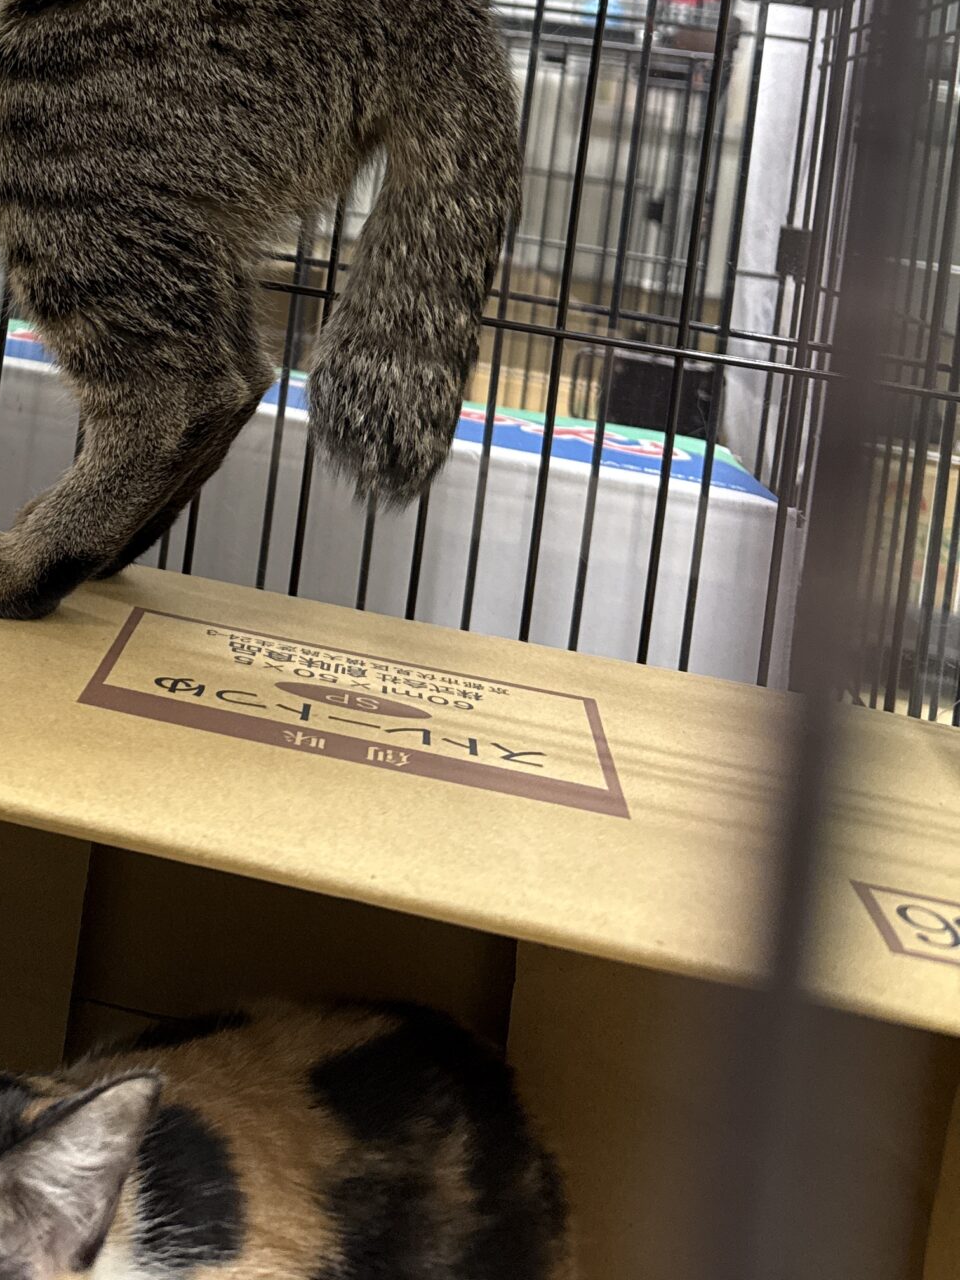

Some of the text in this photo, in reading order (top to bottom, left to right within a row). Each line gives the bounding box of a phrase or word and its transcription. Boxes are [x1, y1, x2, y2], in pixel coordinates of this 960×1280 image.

[325, 693, 379, 711] SP
[381, 685, 474, 711] 60ml
[153, 676, 547, 768] ストレートつゆ
[281, 730, 415, 767] 創味
